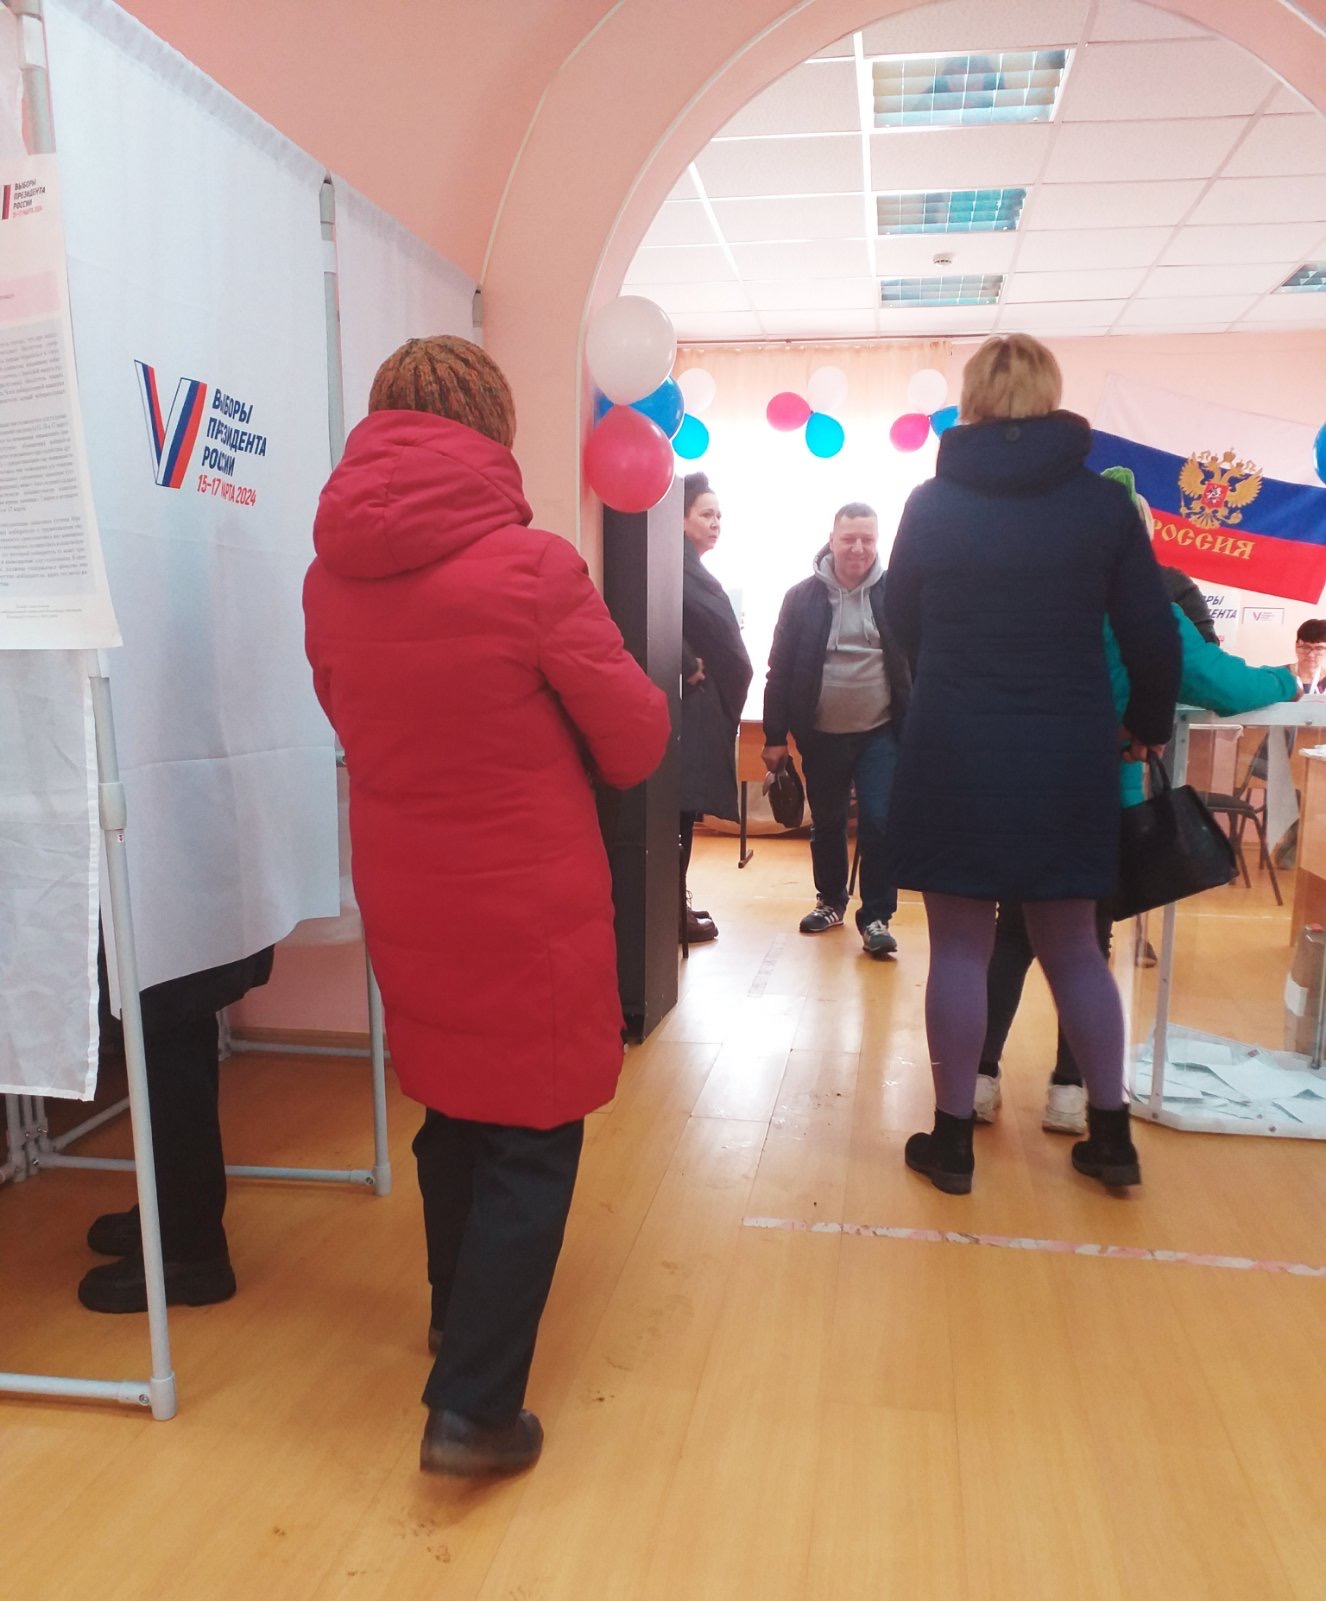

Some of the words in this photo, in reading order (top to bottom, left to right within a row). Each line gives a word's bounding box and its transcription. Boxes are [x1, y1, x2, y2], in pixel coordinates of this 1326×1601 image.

[13, 186, 46, 200] ПРЕЗИДЕНТА
[212, 388, 253, 424] ВЫБОРЫ
[206, 417, 268, 456] ПРЕЗИДЕНТА
[235, 486, 256, 506] 2024
